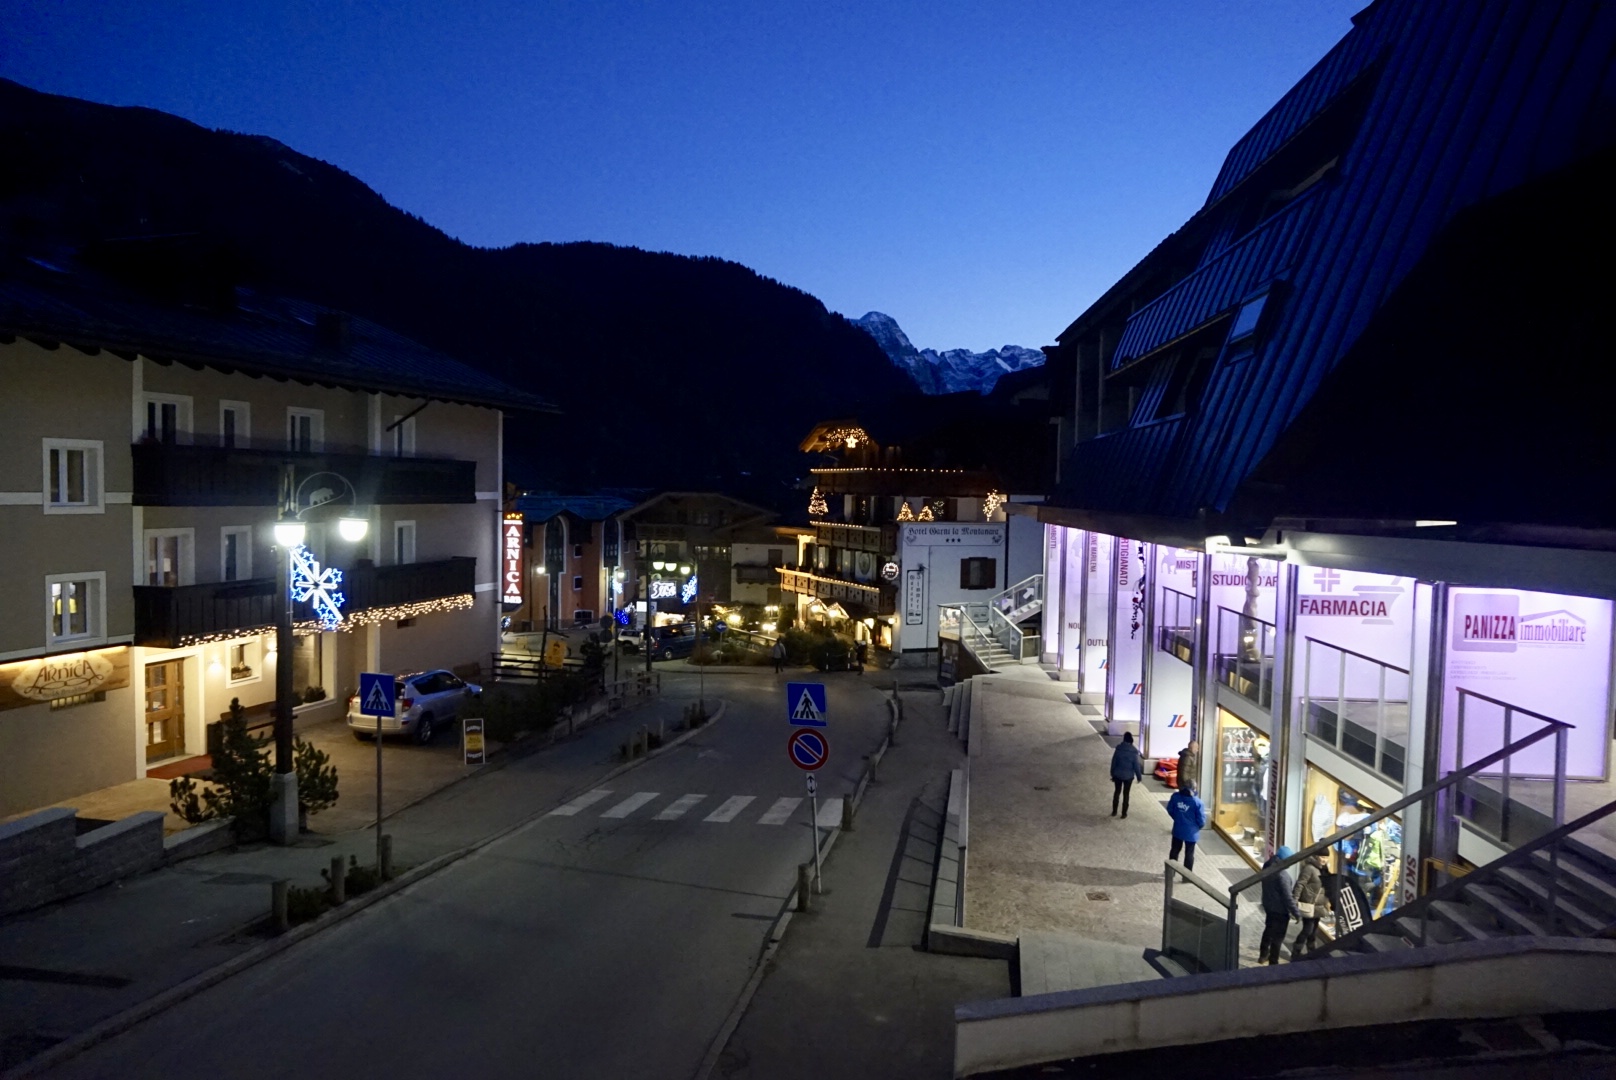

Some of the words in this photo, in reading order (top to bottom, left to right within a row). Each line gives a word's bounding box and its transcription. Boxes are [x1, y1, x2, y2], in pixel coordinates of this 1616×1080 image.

[908, 527, 927, 536] Hotel
[506, 525, 521, 594] ARNICA
[1300, 599, 1387, 616] FARMACIA
[1464, 614, 1516, 640] PANIZZA
[1520, 618, 1586, 642] immobiliare
[1268, 760, 1279, 848] RIPARAZIONI
[1406, 854, 1417, 887] SKI
